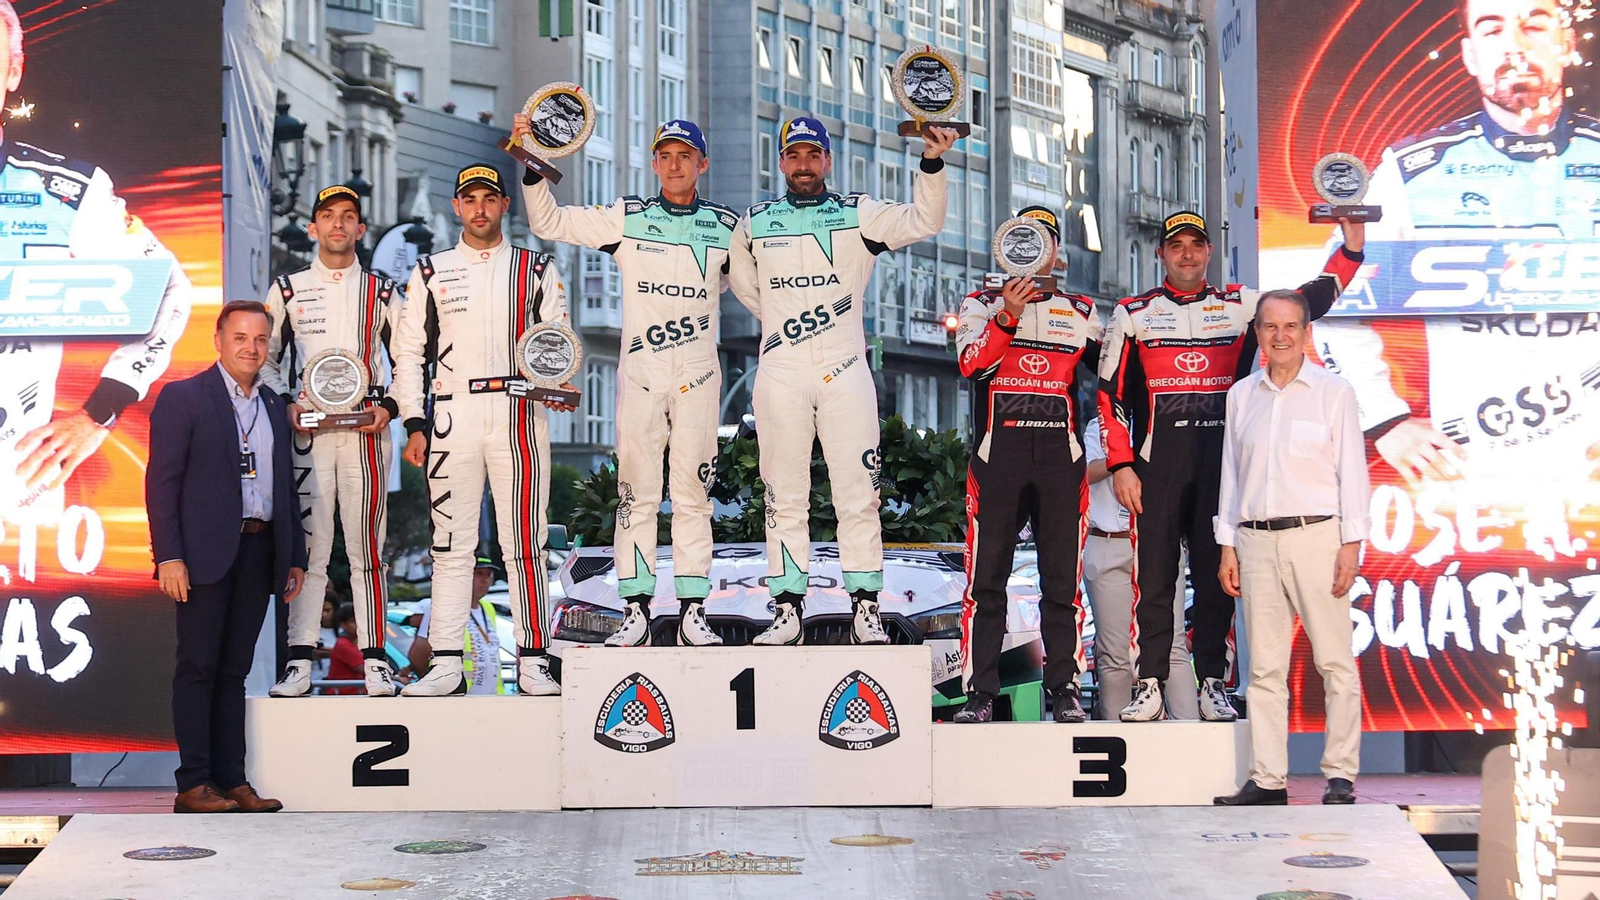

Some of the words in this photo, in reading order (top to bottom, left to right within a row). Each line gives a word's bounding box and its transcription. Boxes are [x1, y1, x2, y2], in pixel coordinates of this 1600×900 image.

[440, 295, 469, 306] QUARTZ
[645, 316, 696, 346] GSS
[782, 304, 831, 340] GSS
[812, 322, 836, 337] Services
[675, 335, 699, 347] Services
[990, 376, 1041, 388] BREOGÁN
[1149, 375, 1201, 387] BREOGÁN
[1202, 376, 1233, 386] MOTOR
[1477, 375, 1571, 438] GSS
[428, 342, 453, 552] LANCIA
[0, 596, 94, 683] AS
[596, 678, 634, 735] ESCUDERIA
[729, 667, 757, 731] 1
[820, 676, 855, 734] ESCUDERIA
[352, 724, 410, 787] 2
[621, 743, 648, 753] VIGO
[846, 741, 873, 750] VIGO
[1072, 736, 1128, 798] 3
